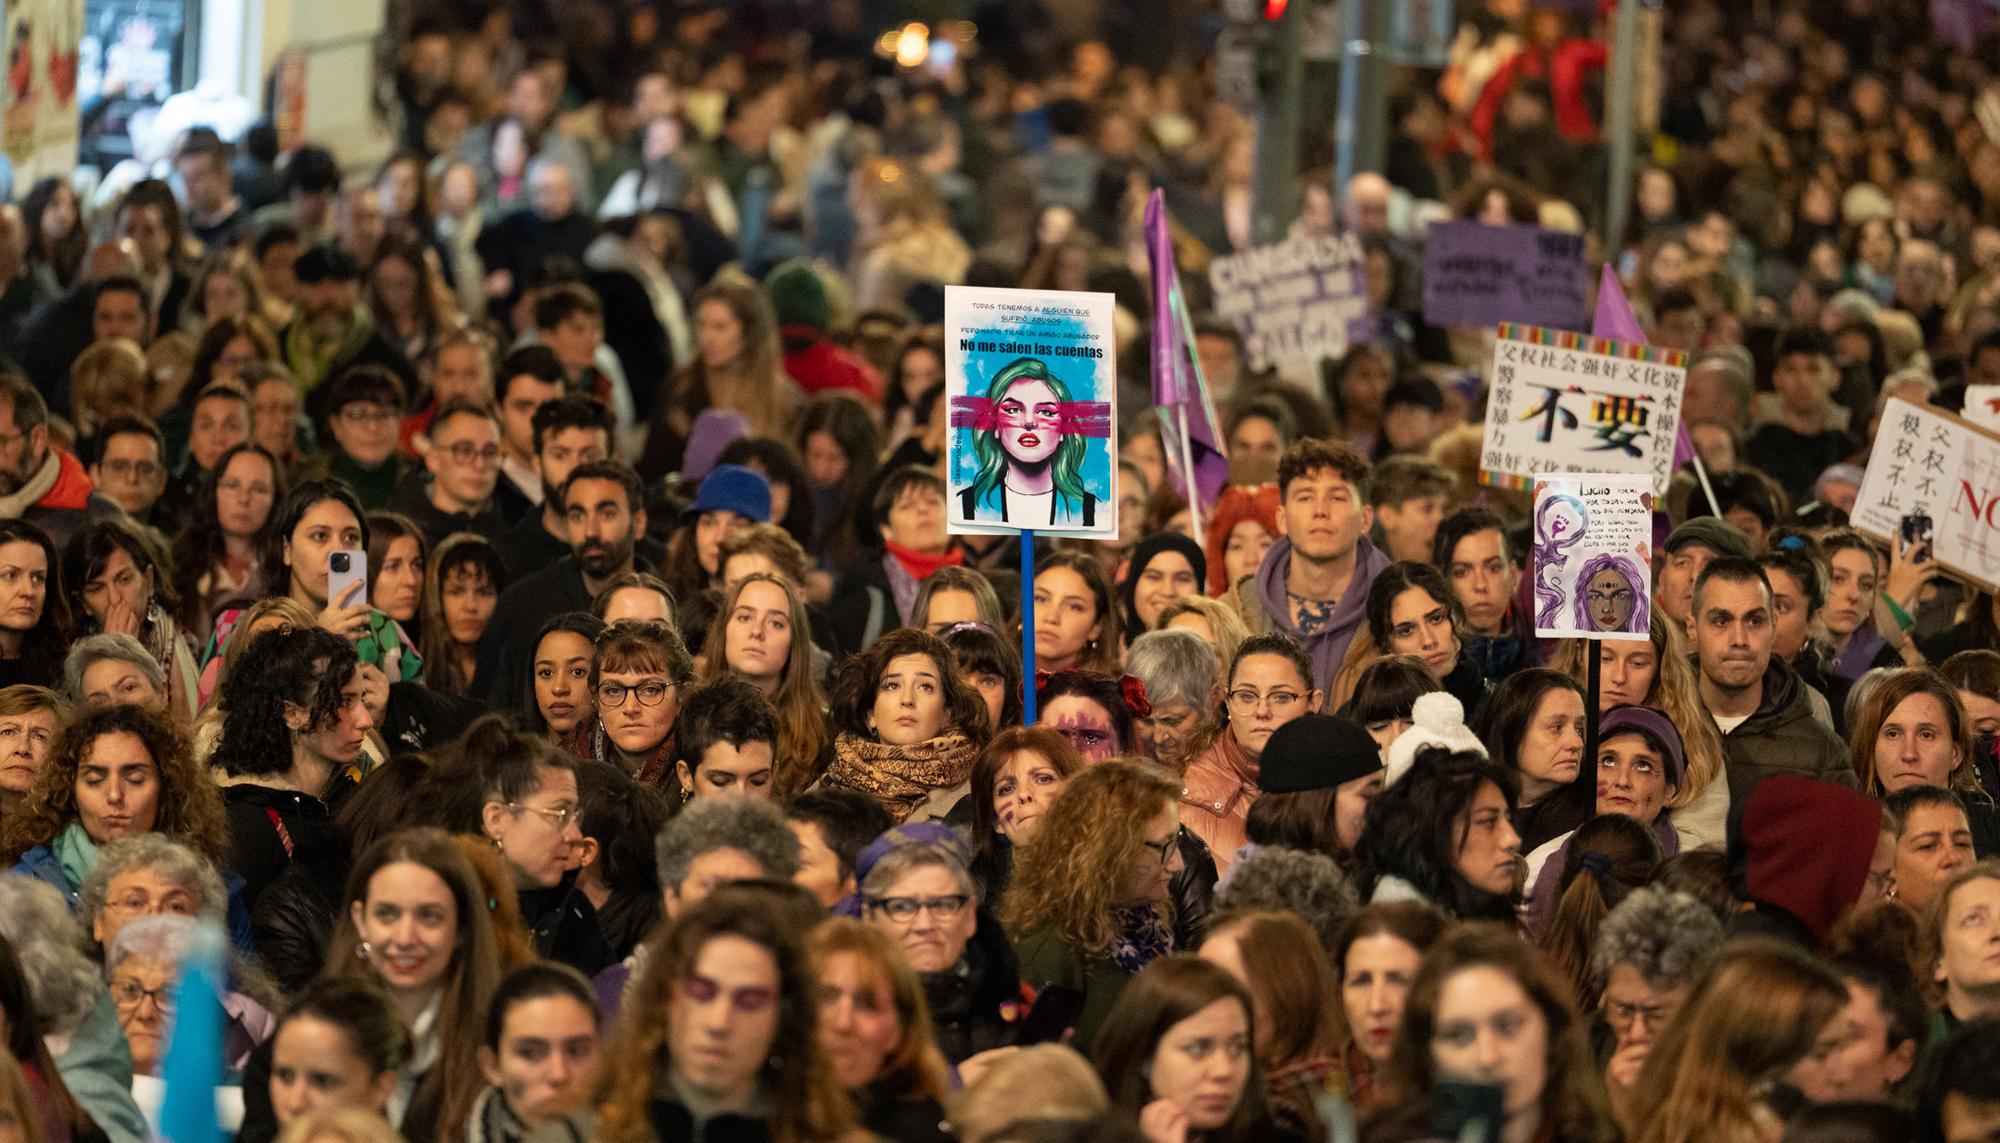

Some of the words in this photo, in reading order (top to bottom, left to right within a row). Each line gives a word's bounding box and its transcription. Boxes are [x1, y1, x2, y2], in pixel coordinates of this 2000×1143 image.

[972, 302, 995, 310] TODAS
[998, 304, 1032, 312] TENEMOS
[1042, 306, 1074, 315] ALGUIEN
[1001, 314, 1028, 322] SUFRIÓ
[1032, 317, 1062, 325] ABUSOS
[960, 339, 975, 351] No
[977, 342, 996, 352] me
[998, 341, 1032, 355] salen
[1035, 343, 1052, 355] las
[1055, 346, 1103, 358] cuentas
[1517, 381, 1656, 459] 不要
